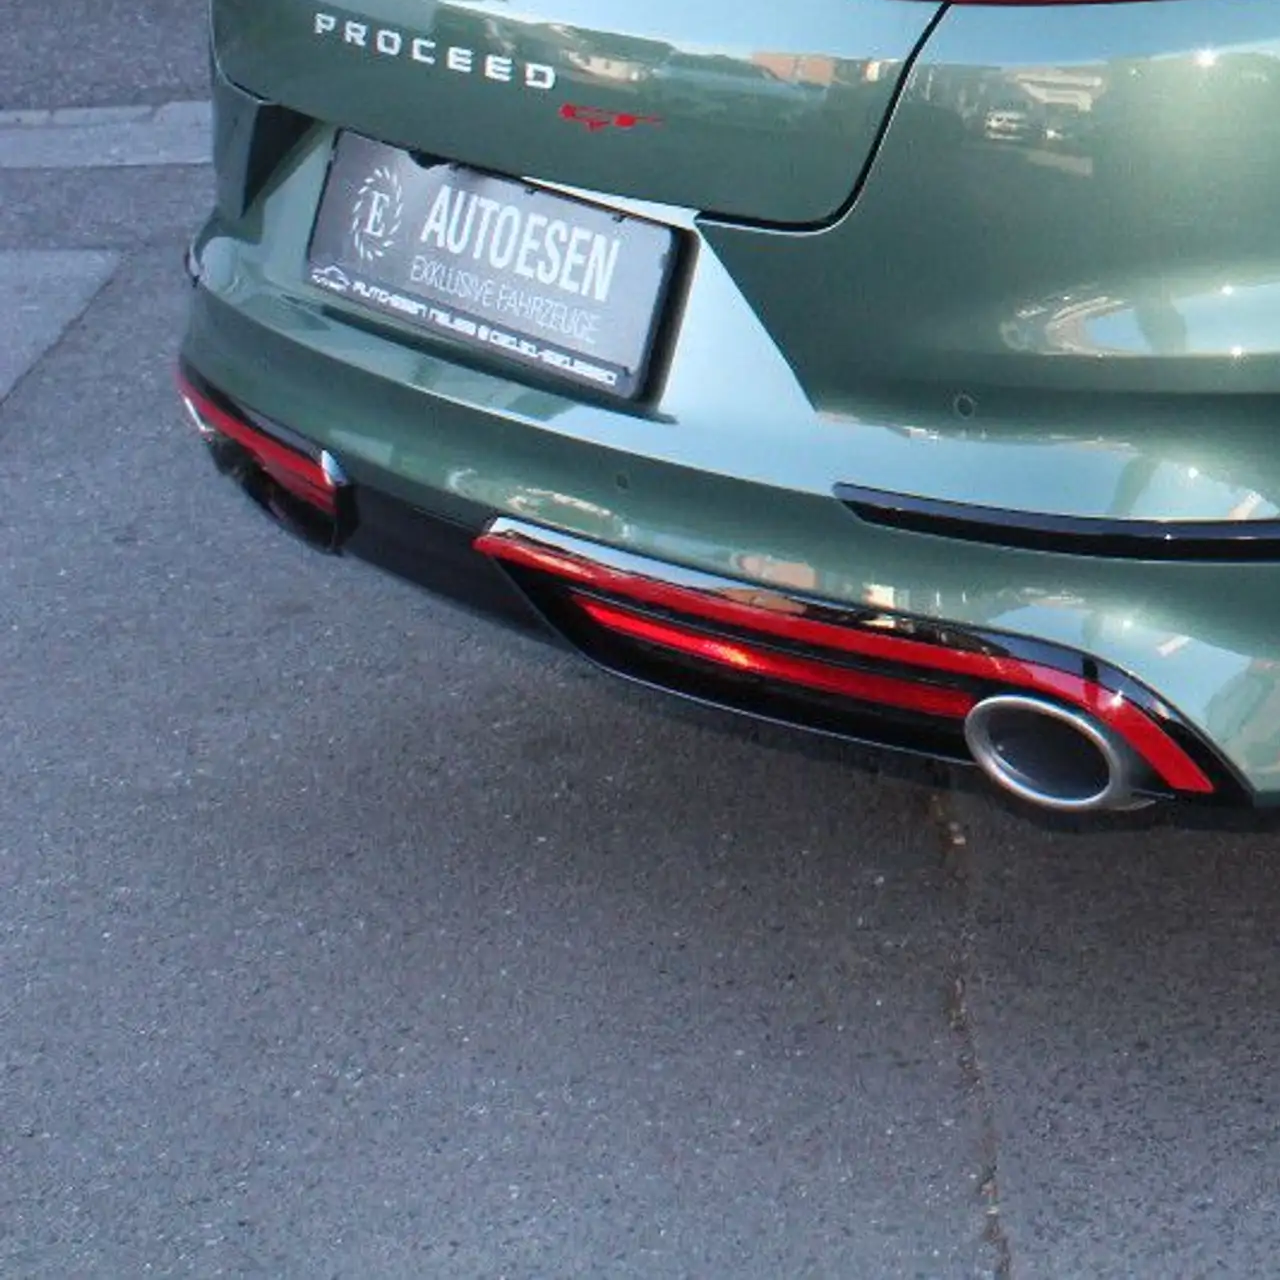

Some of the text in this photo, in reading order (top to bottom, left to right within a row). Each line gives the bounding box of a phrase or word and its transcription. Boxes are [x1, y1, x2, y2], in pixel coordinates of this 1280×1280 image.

[313, 12, 556, 90] PROCEED
[409, 254, 496, 308] EXKLUSIVE
[419, 184, 620, 303] AUTOESEN
